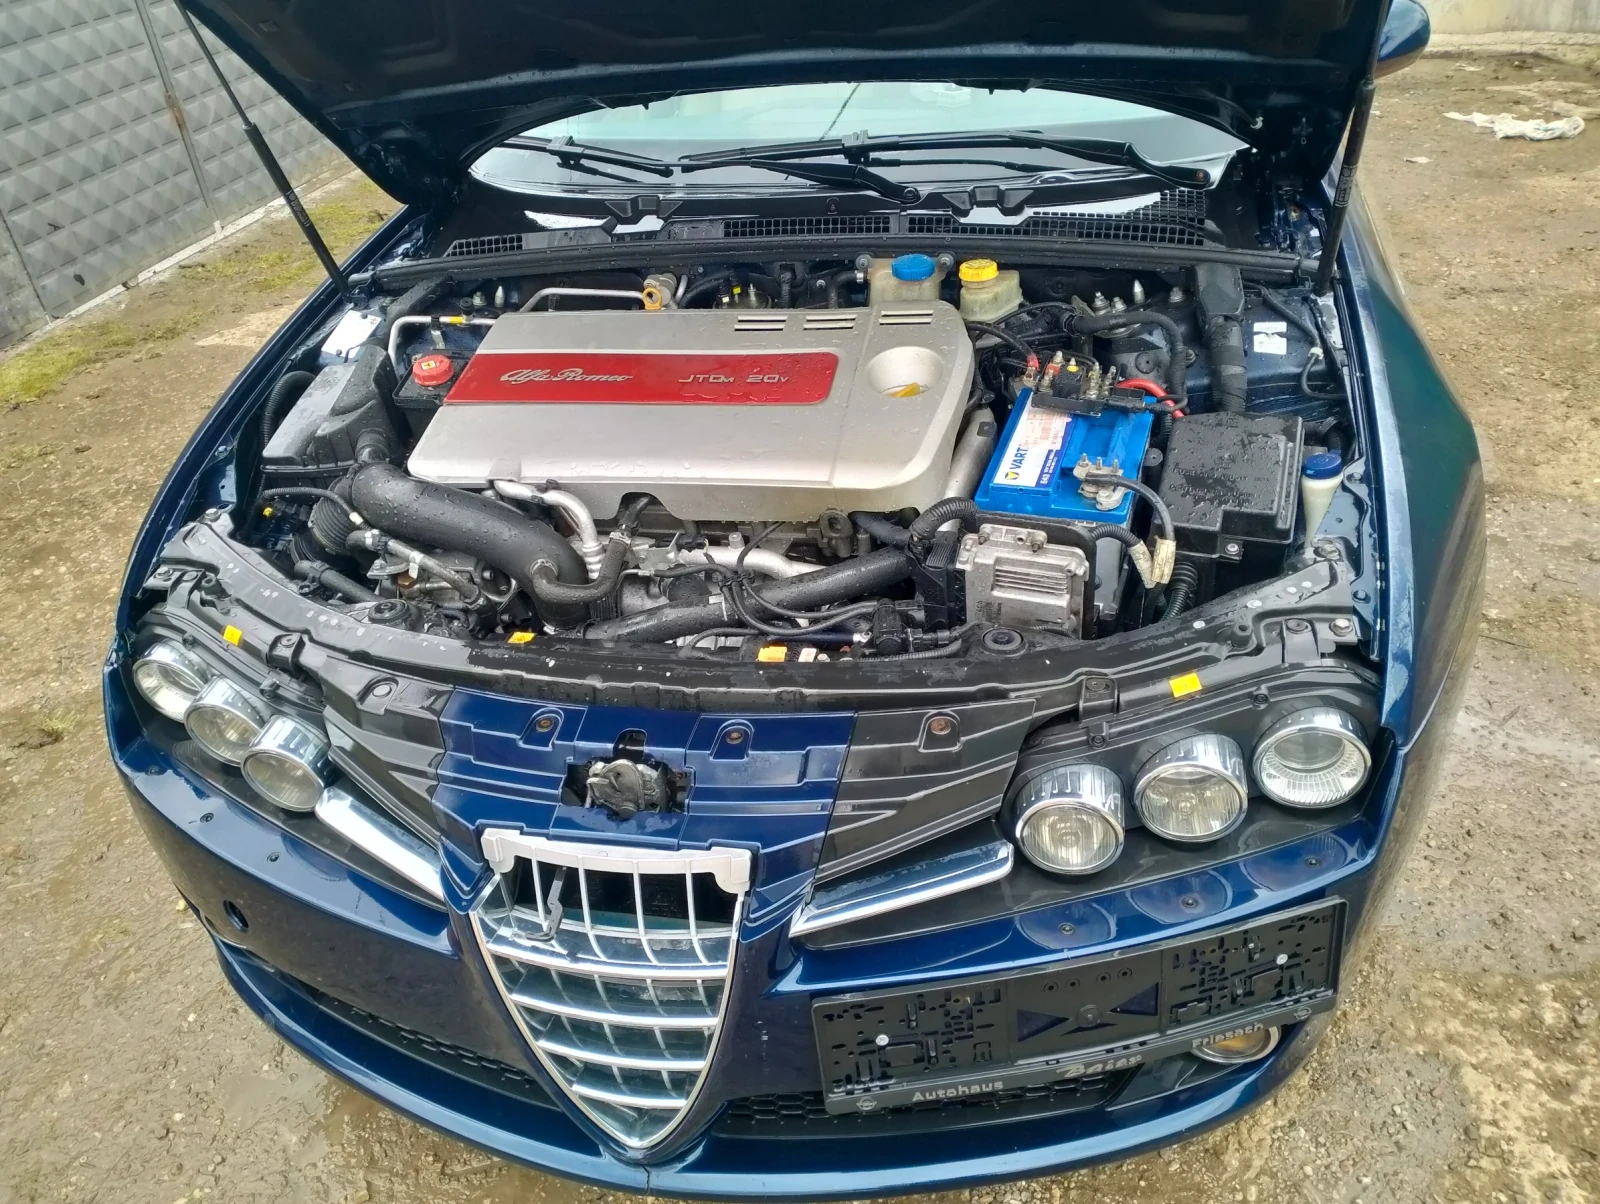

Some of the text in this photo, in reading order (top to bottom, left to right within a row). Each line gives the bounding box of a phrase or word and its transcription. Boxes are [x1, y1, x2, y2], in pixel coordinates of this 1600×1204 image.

[499, 367, 634, 385] Alfa Romeo
[1008, 443, 1030, 470] VART
[912, 1080, 1004, 1102] Autohaus
[1192, 1022, 1264, 1048] Friesach
